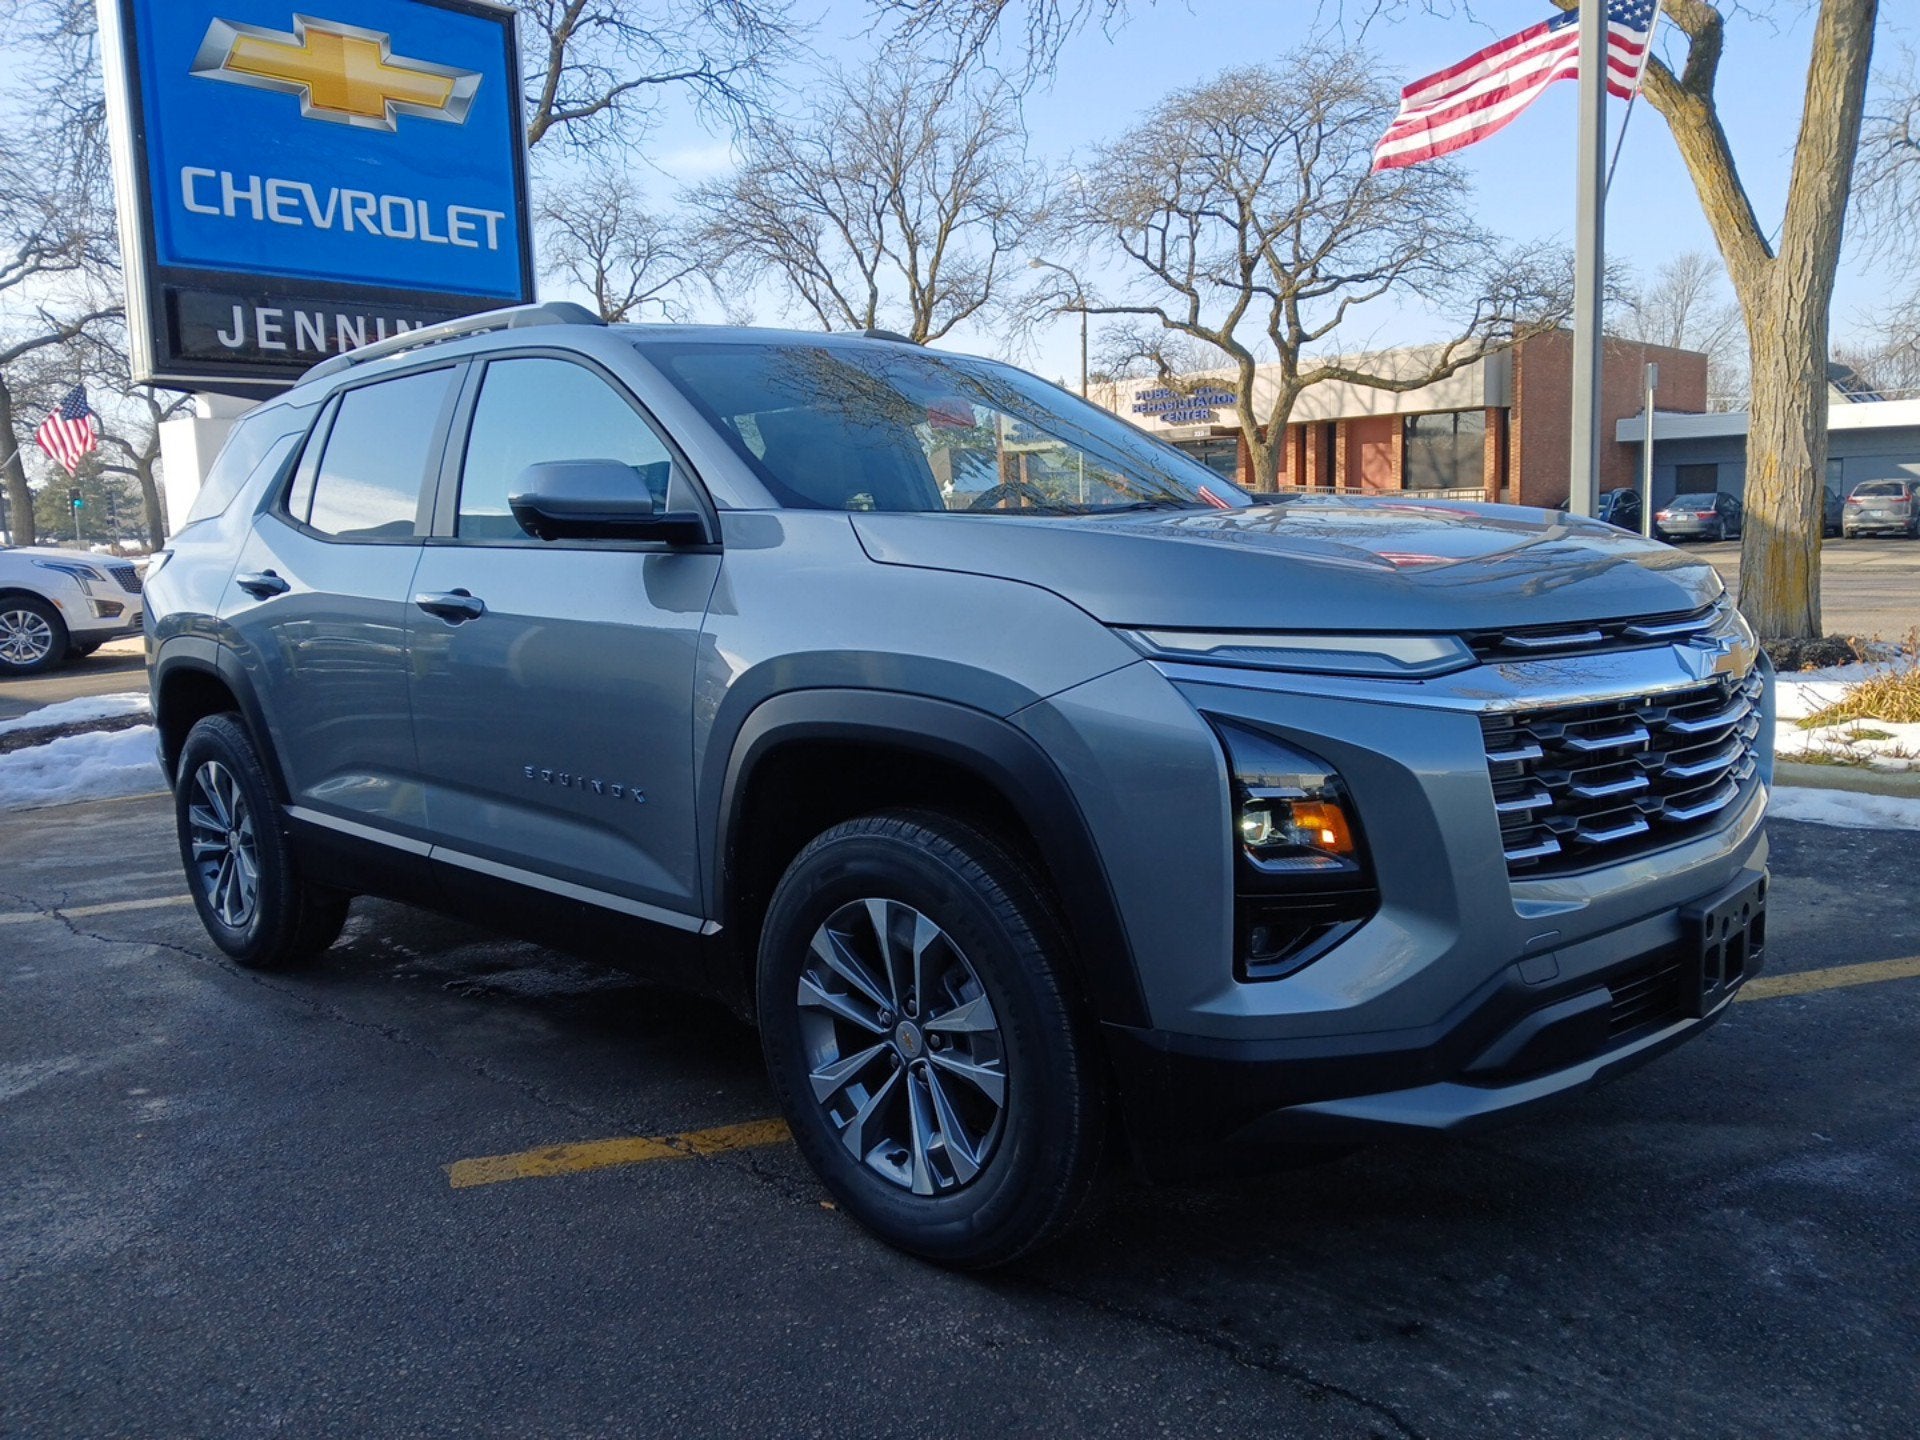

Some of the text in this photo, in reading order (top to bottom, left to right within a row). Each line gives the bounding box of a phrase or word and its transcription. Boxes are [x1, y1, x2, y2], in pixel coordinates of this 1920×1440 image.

[181, 166, 505, 250] CHEVROLET
[217, 305, 491, 353] JENNI
[1132, 394, 1237, 413] REHABILITATION
[1160, 409, 1210, 422] CENTER
[524, 765, 646, 804] EQUINOX
